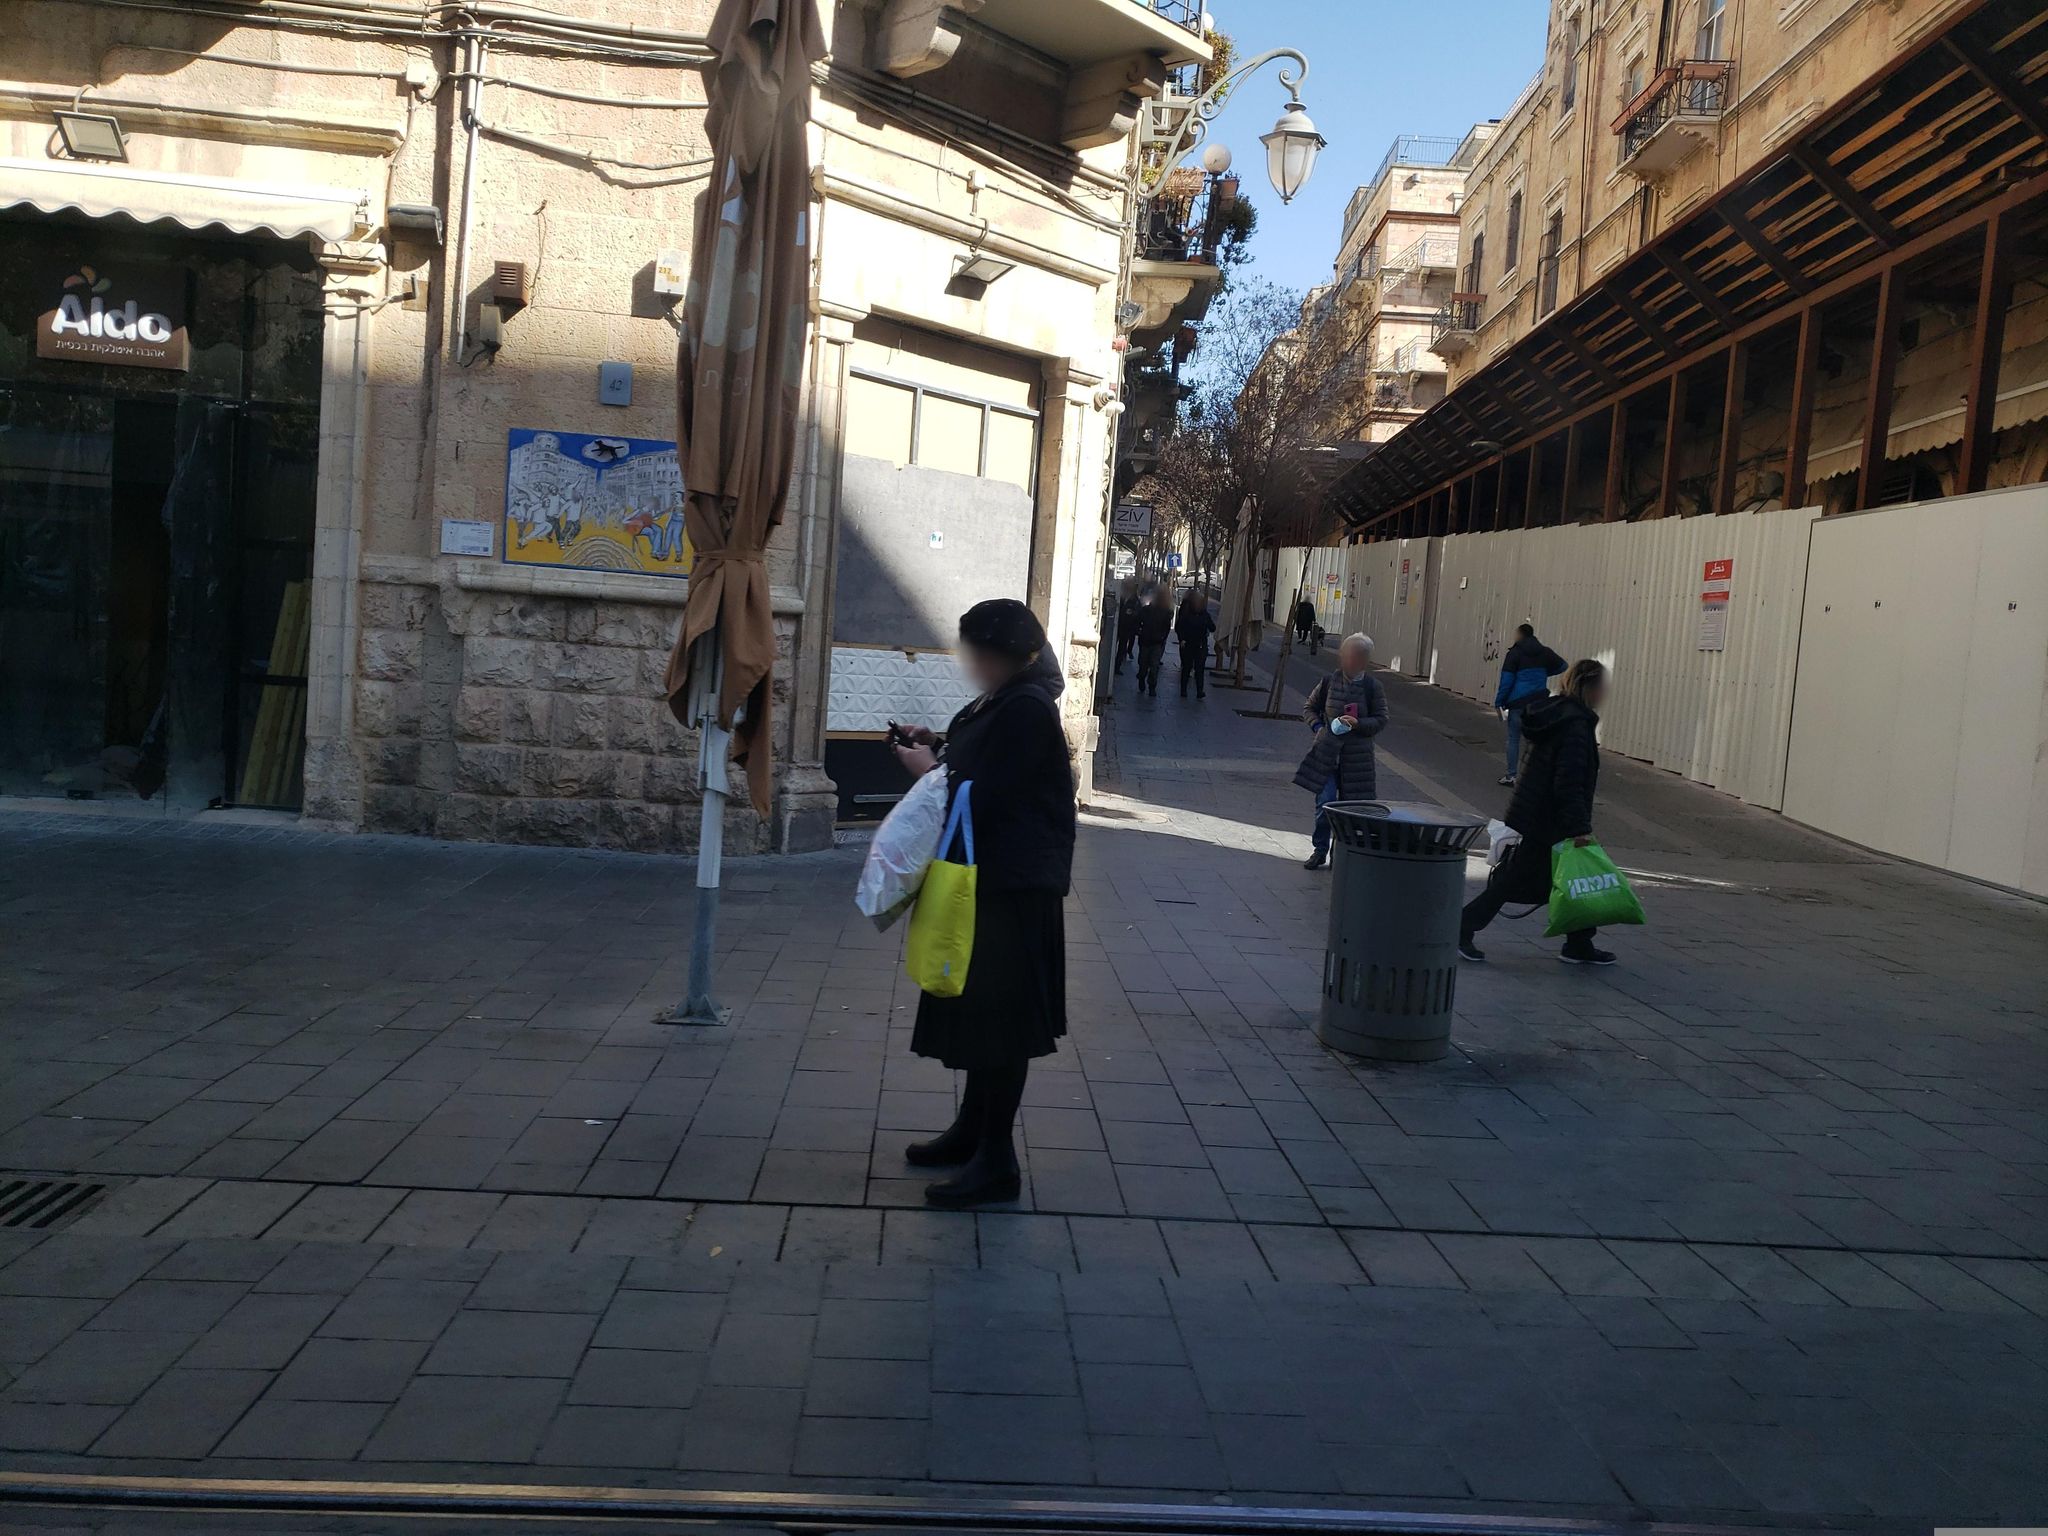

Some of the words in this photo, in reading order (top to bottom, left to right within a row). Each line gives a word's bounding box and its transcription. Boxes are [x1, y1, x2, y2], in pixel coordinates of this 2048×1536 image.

[51, 293, 172, 343] Aldo
[90, 343, 133, 355] איטלקית
[136, 347, 165, 358] אהבה
